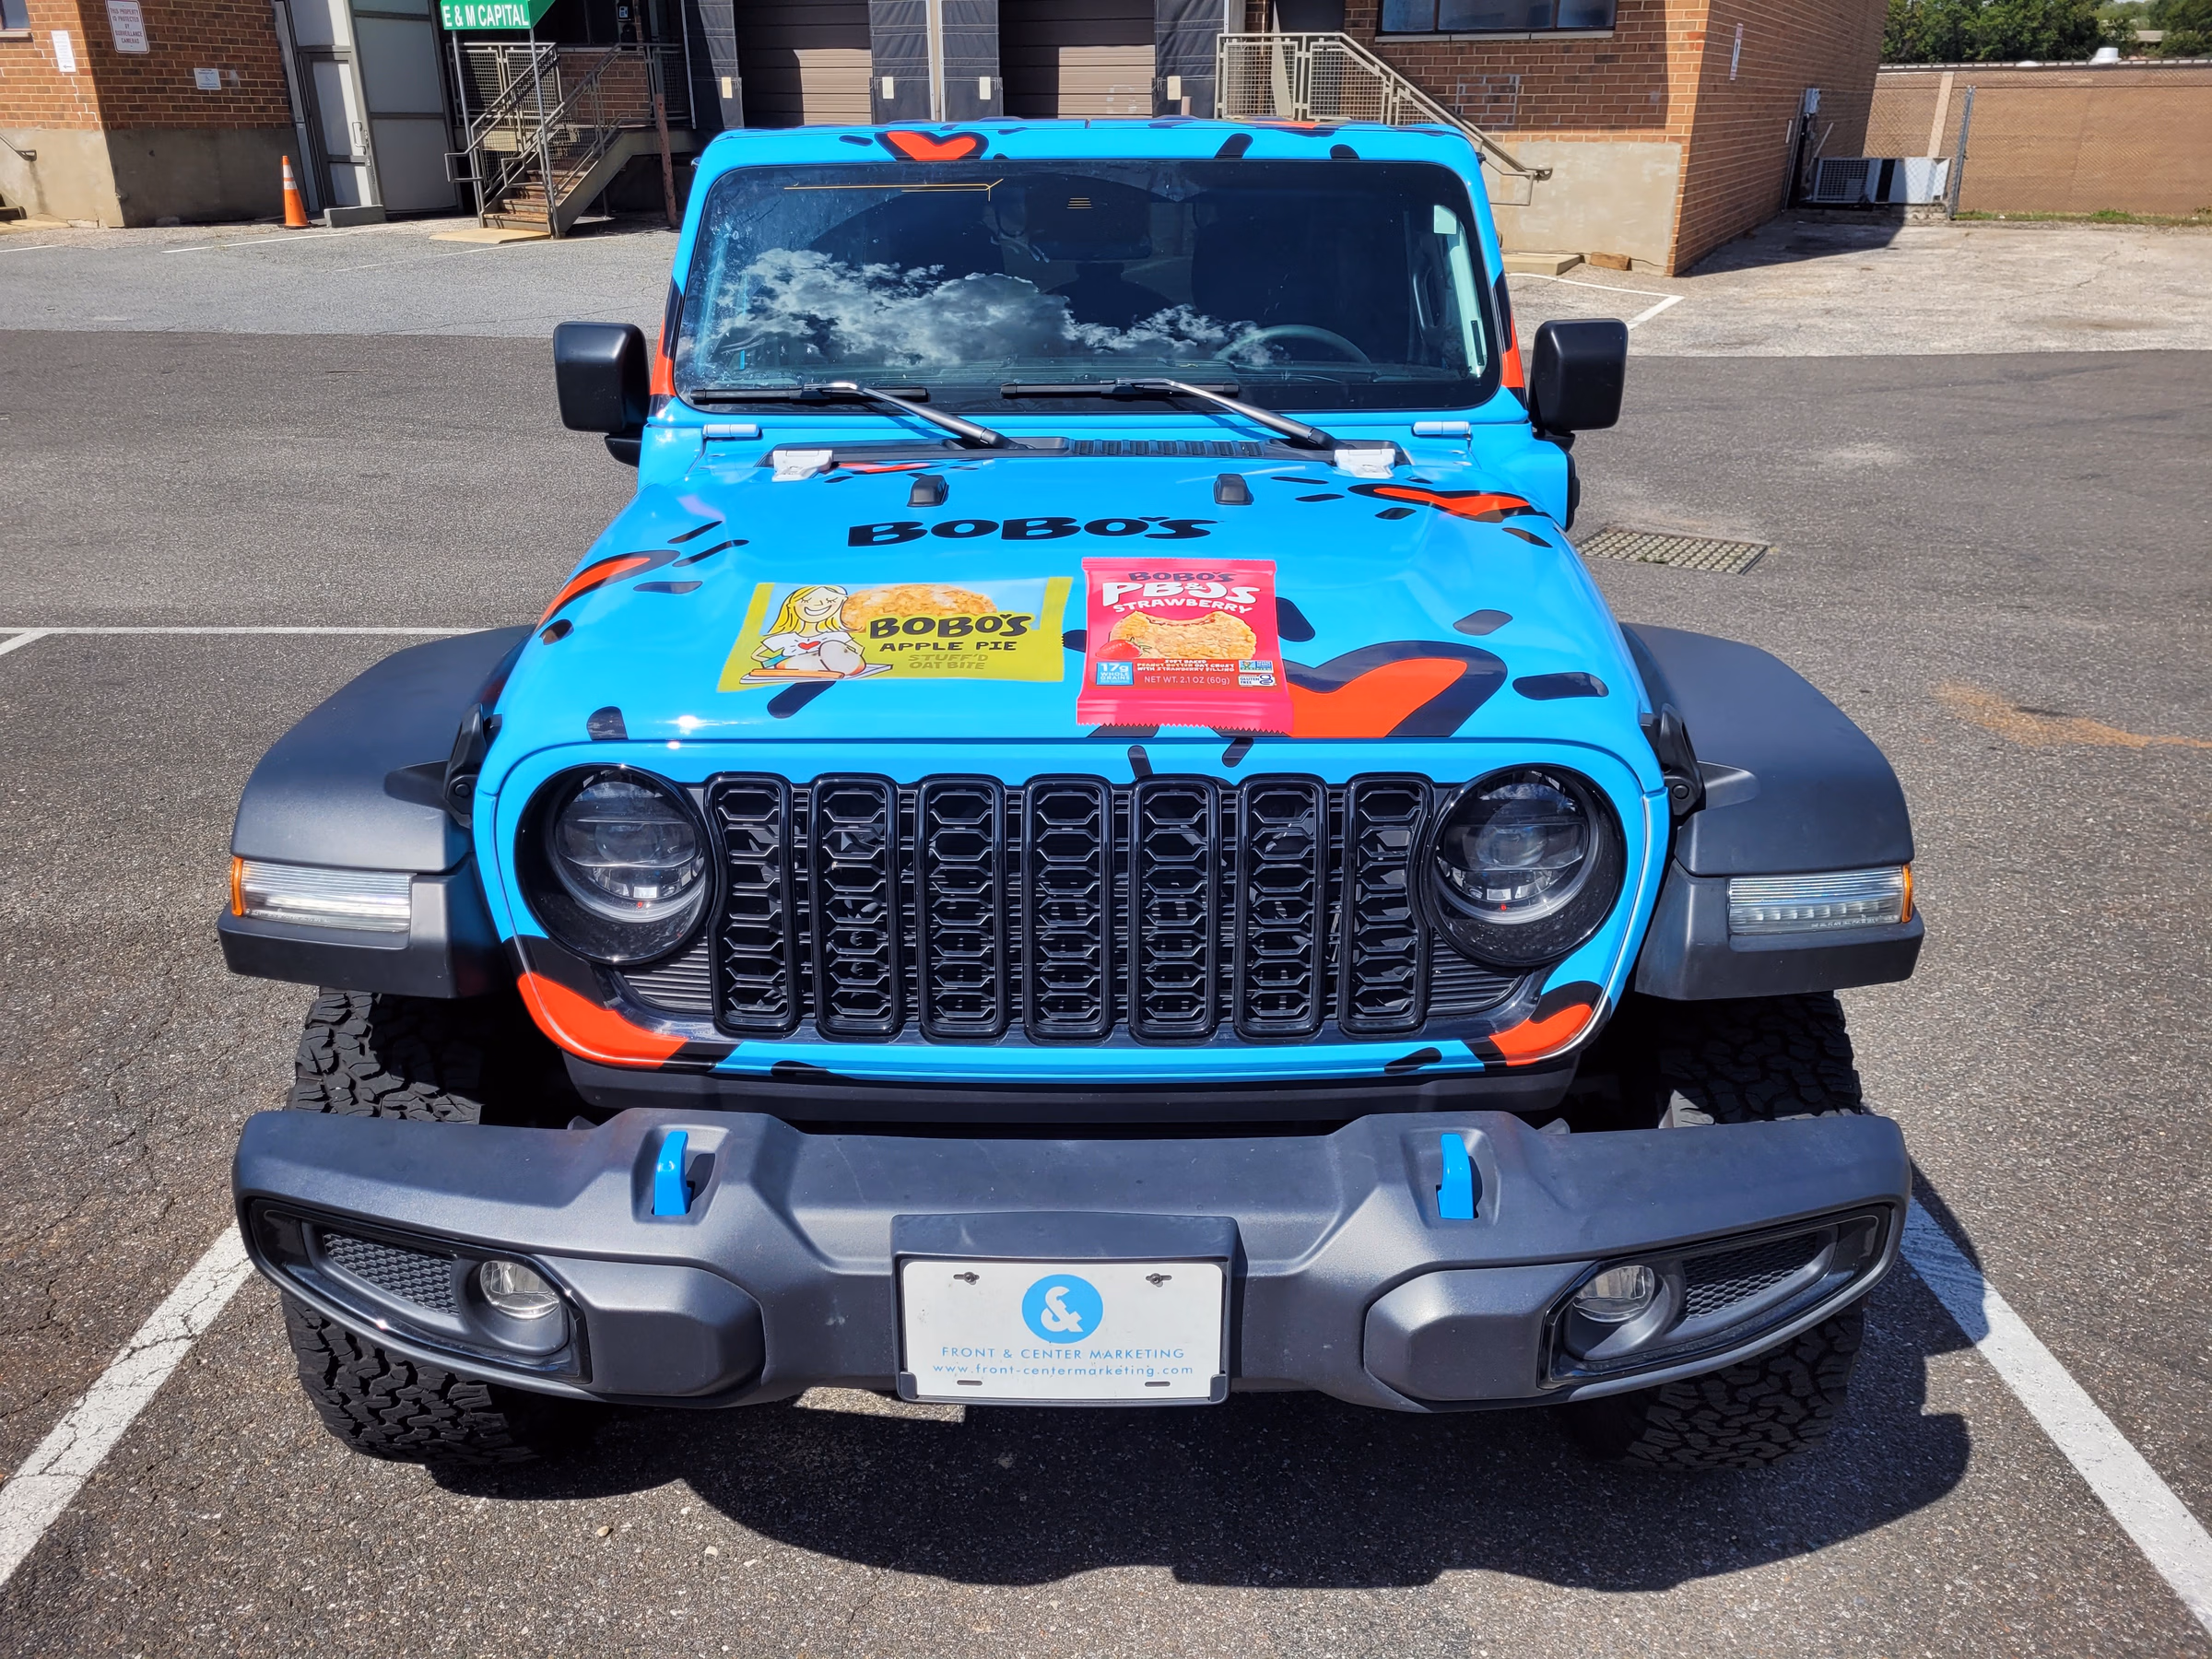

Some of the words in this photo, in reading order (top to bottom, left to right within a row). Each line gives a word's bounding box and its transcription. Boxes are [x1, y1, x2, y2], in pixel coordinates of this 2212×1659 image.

[442, 6, 453, 27] E
[454, 6, 464, 27] &
[465, 6, 477, 27] M
[478, 5, 529, 27] CAPITAL
[847, 516, 1220, 547] BOBO'S
[1128, 571, 1237, 582] BOBO'S
[1113, 598, 1253, 614] STRAWBERRY
[869, 614, 1032, 639] BOBO'S
[879, 641, 964, 652] APPLE
[975, 641, 1018, 651] PIE
[908, 653, 989, 662] STUFF'D
[947, 662, 985, 670] BITE
[1100, 663, 1129, 672] 17g
[1206, 677, 1230, 685] (60g)
[1041, 1286, 1084, 1333] &
[942, 1347, 995, 1358] FRONT
[1003, 1349, 1013, 1359] &
[1020, 1348, 1082, 1359] CENTER
[1088, 1348, 1185, 1359] MARKETING
[933, 1362, 1194, 1377] www.front-centermarketing.com
